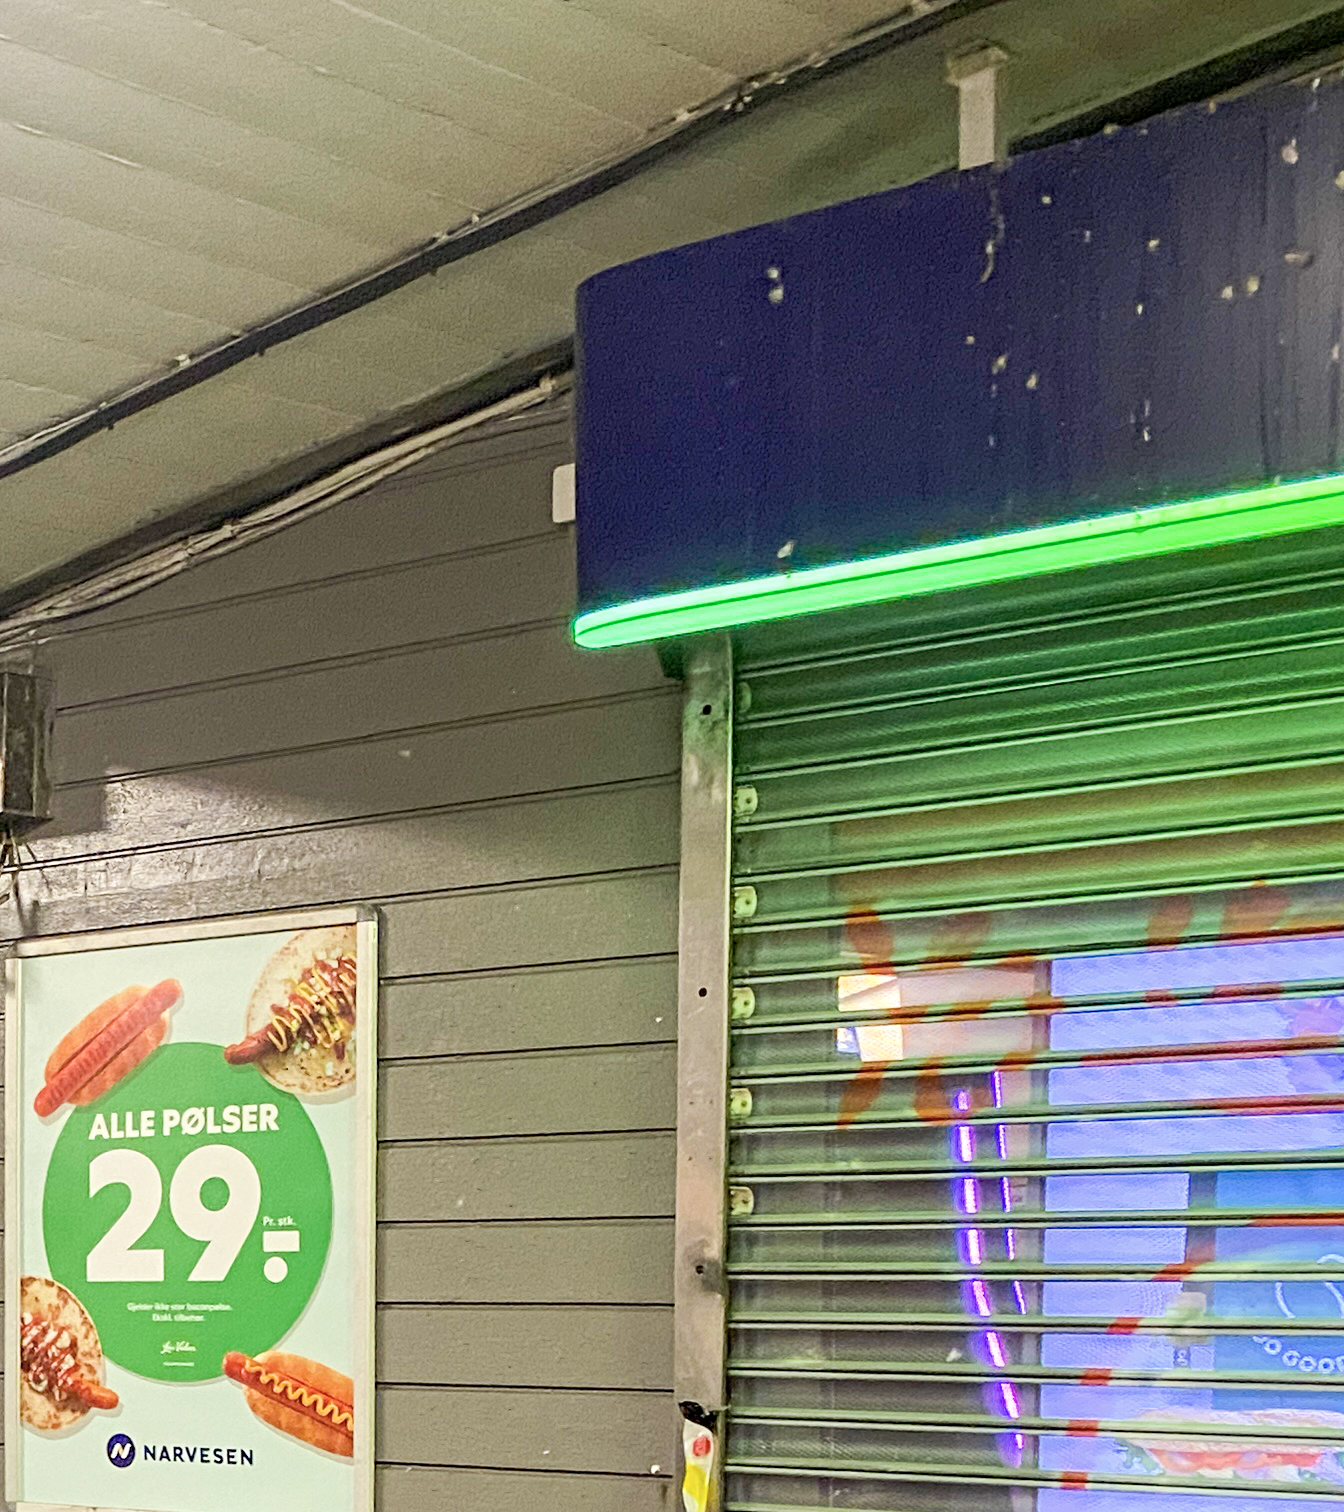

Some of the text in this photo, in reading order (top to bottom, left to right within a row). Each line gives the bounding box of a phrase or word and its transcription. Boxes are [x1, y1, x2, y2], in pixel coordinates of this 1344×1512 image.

[88, 1103, 280, 1140] ALLE PØLSER
[144, 1444, 254, 1466] NARVESEN
